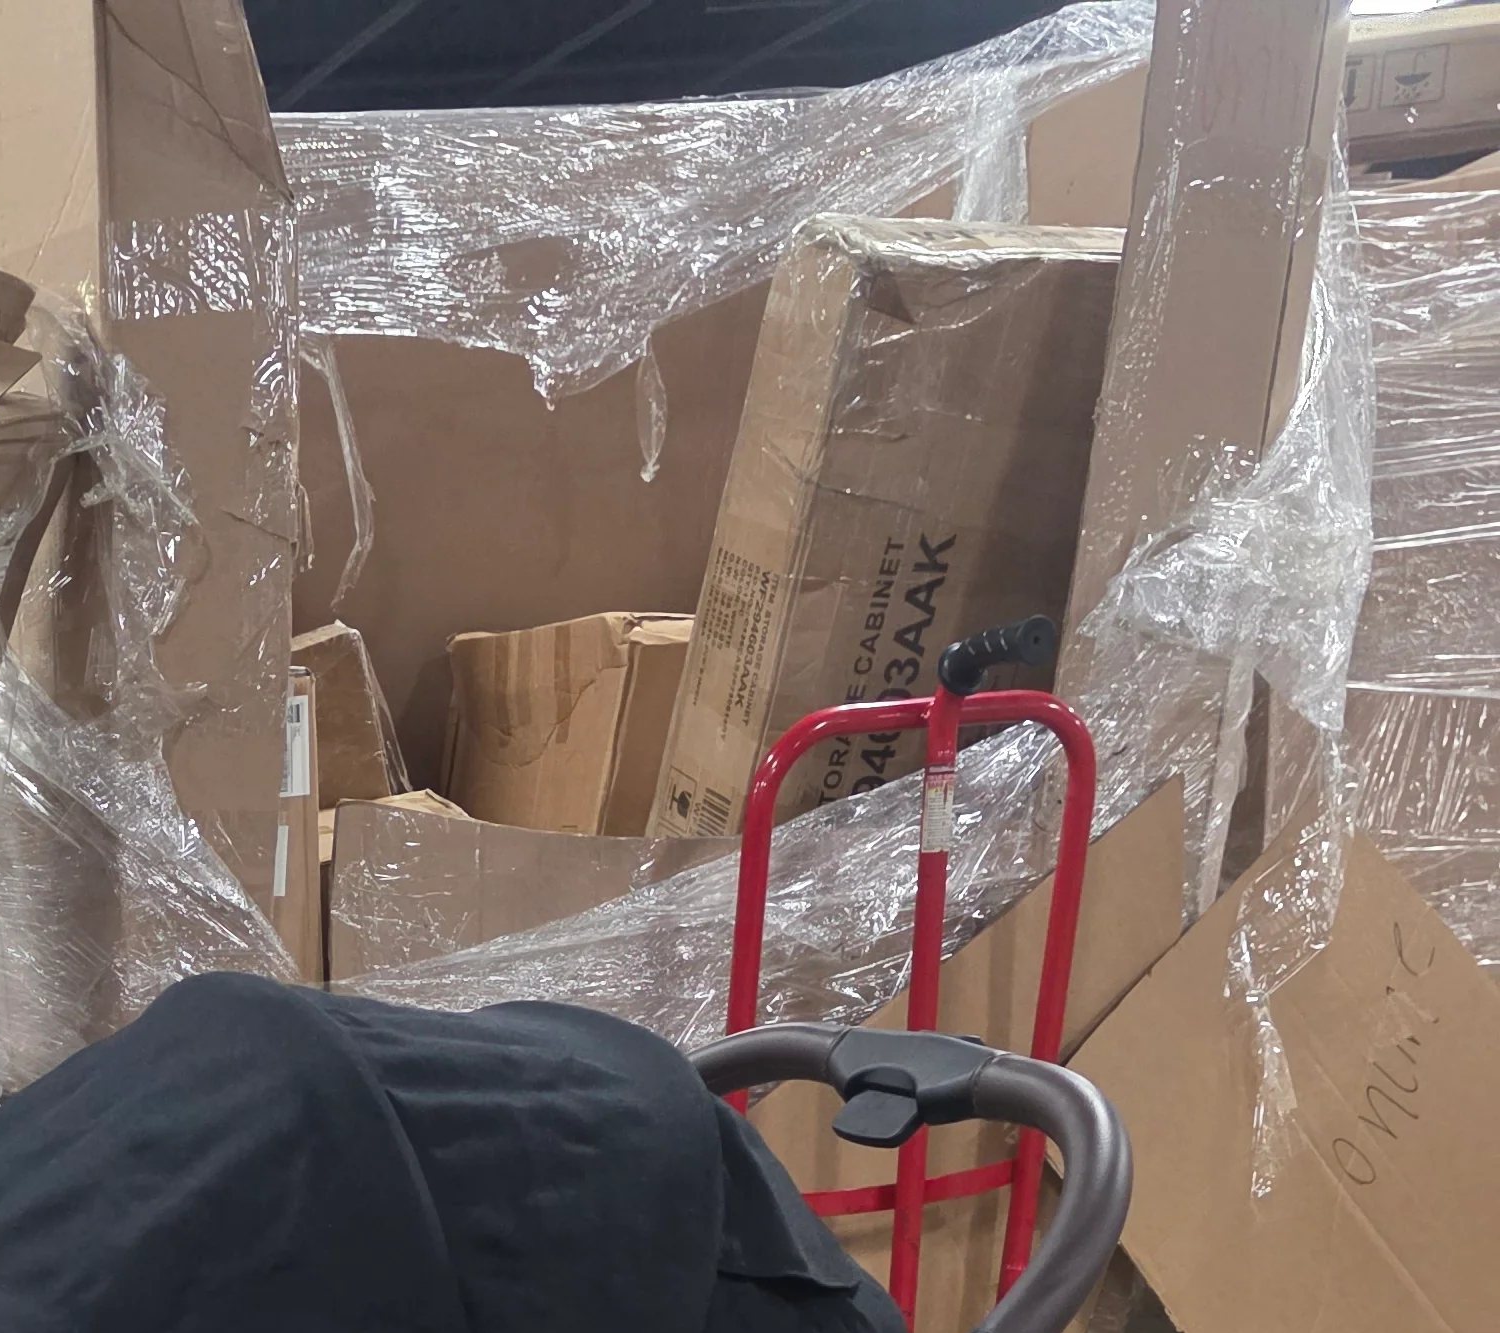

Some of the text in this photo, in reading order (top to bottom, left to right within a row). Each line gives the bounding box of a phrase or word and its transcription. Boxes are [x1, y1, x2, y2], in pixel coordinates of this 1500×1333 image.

[854, 537, 904, 675] CABINET
[753, 608, 771, 670] STORAGE
[741, 671, 758, 727] CABINET
